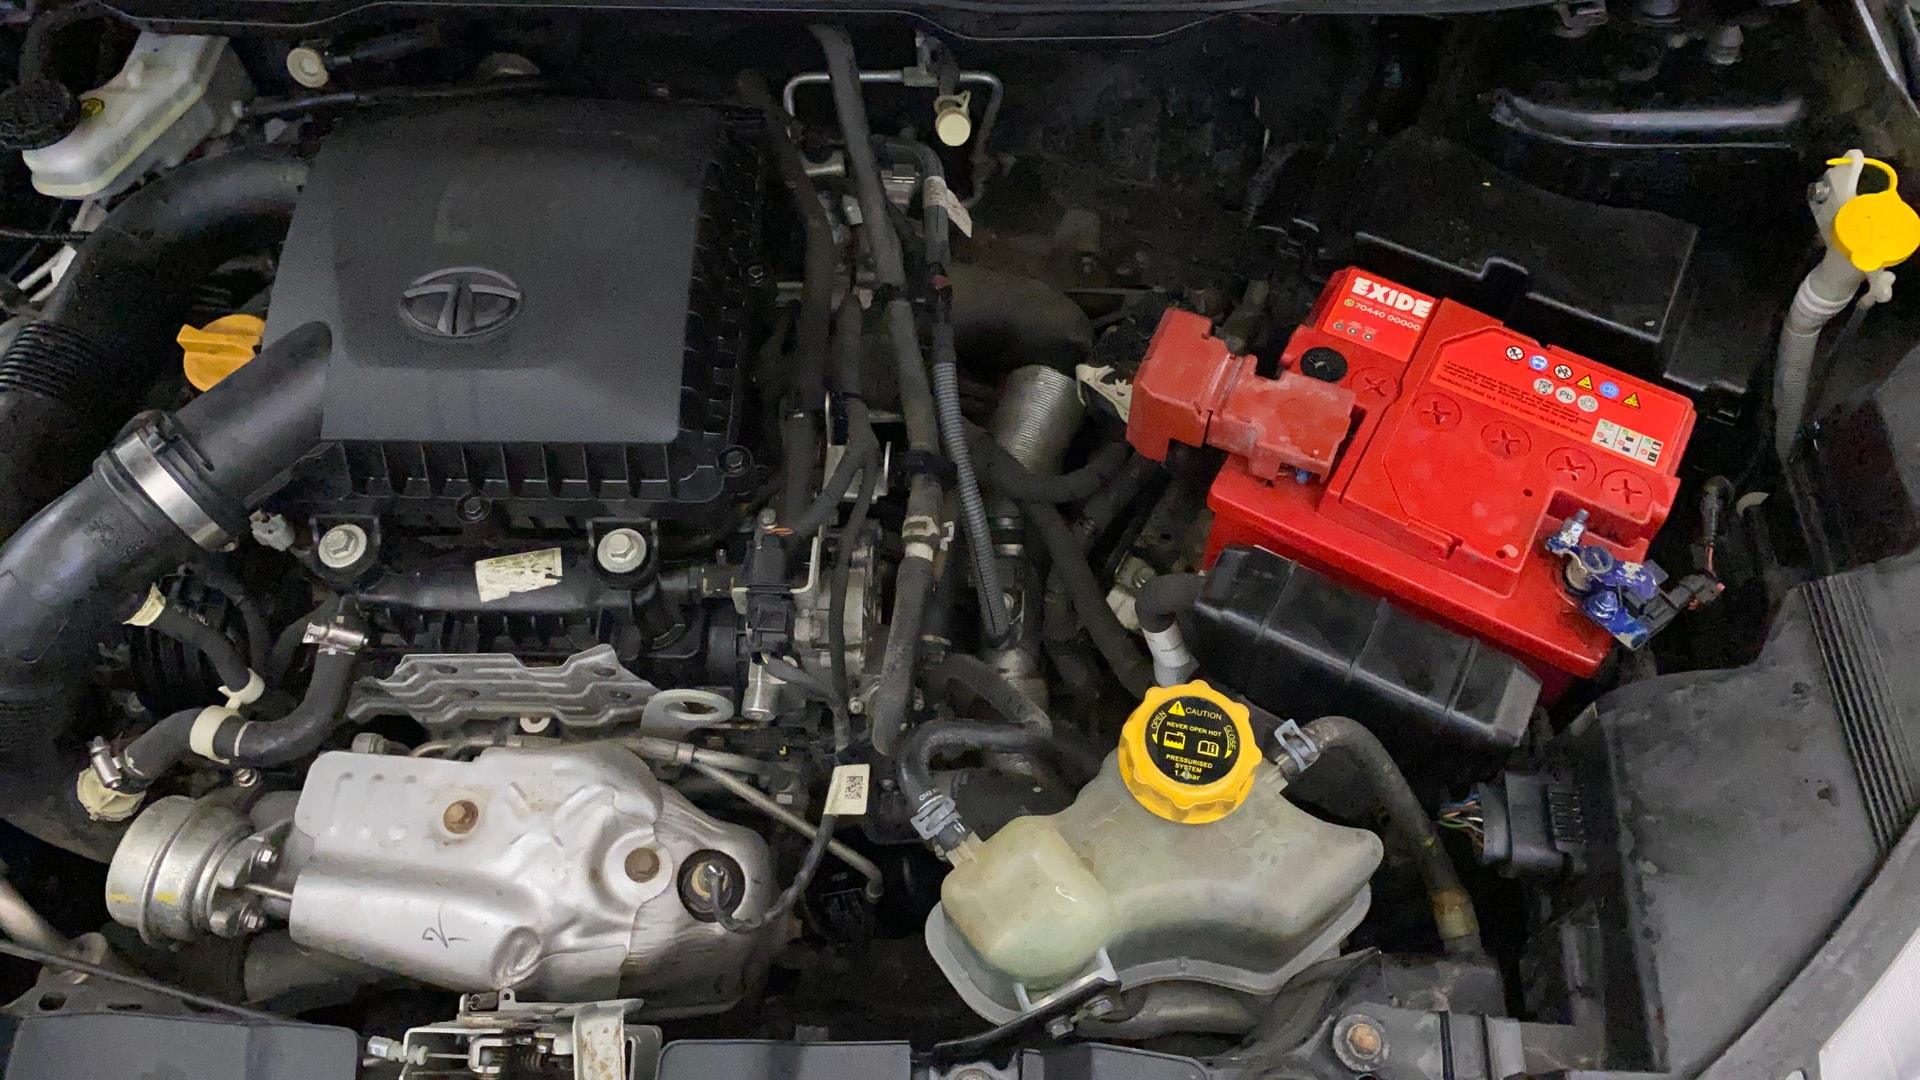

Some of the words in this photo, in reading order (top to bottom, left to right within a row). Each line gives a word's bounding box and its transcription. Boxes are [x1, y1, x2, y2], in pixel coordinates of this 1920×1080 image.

[1352, 277, 1433, 318] EXIDE
[1354, 302, 1386, 318] 70440
[1387, 314, 1421, 331] 00000
[1559, 390, 1573, 401] Pb
[1151, 710, 1166, 729] OPEN
[1185, 707, 1222, 720] CAUTION
[1166, 721, 1188, 730] NEVER
[1189, 725, 1207, 734] OPEN
[1208, 729, 1222, 737] HOT
[1225, 724, 1236, 750] CLOSE
[1166, 753, 1213, 769] PRESSURISED
[1174, 762, 1202, 773] SYSTEM
